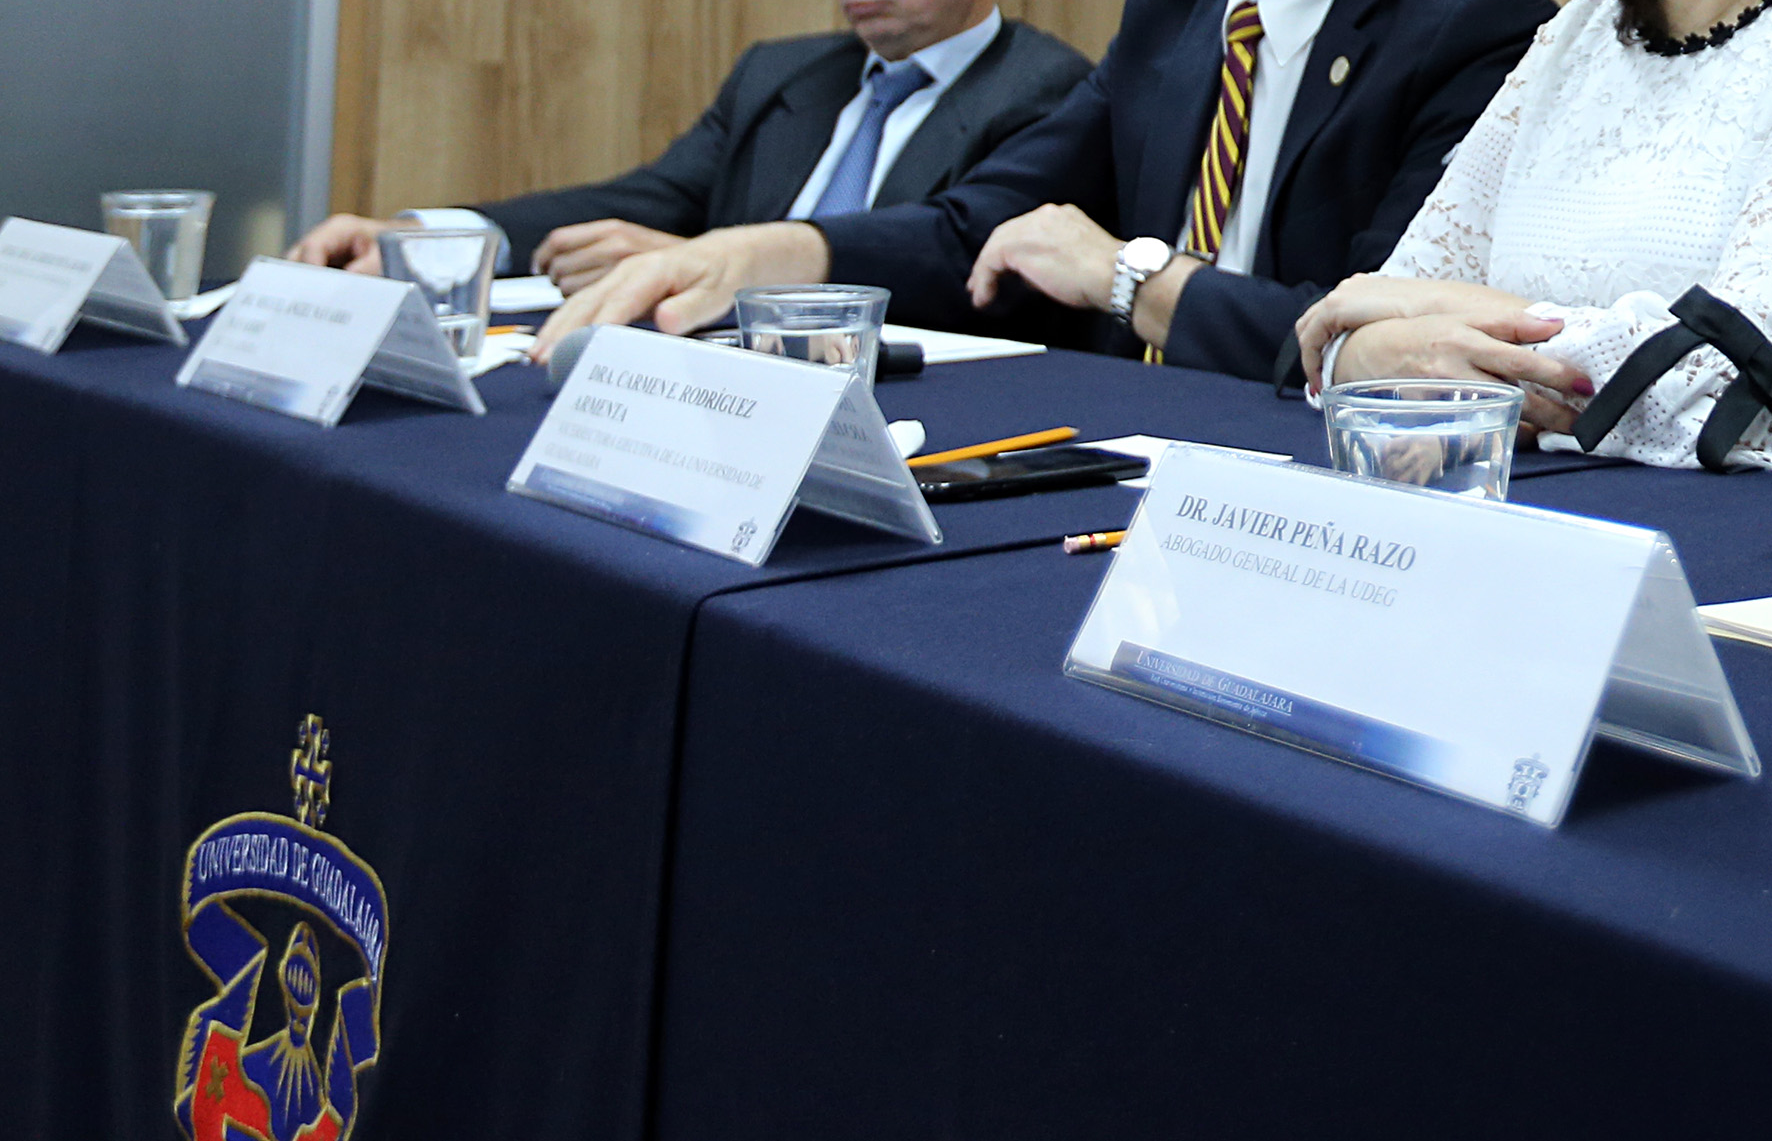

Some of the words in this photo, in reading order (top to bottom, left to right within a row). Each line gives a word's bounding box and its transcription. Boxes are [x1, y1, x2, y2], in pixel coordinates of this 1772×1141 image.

[574, 394, 629, 423] ARMENTA
[616, 370, 667, 396] CARMEN
[679, 383, 758, 419] RODRÍGUEZ
[1176, 494, 1208, 523] DR.
[1212, 503, 1289, 542] JAVIER
[1288, 520, 1346, 556] PEÑA
[1348, 534, 1417, 572] RAZO
[1160, 533, 1232, 564] ABOGADO
[1232, 550, 1299, 583] GENERAL
[1301, 567, 1328, 590] DE
[1325, 573, 1347, 596] LA
[1350, 579, 1399, 608] UDEG
[1217, 676, 1294, 713] GUADALAJARA
[198, 833, 289, 883] UNIVERSIDAD
[292, 842, 310, 886] DE
[311, 852, 383, 981] GUADALAJARA
